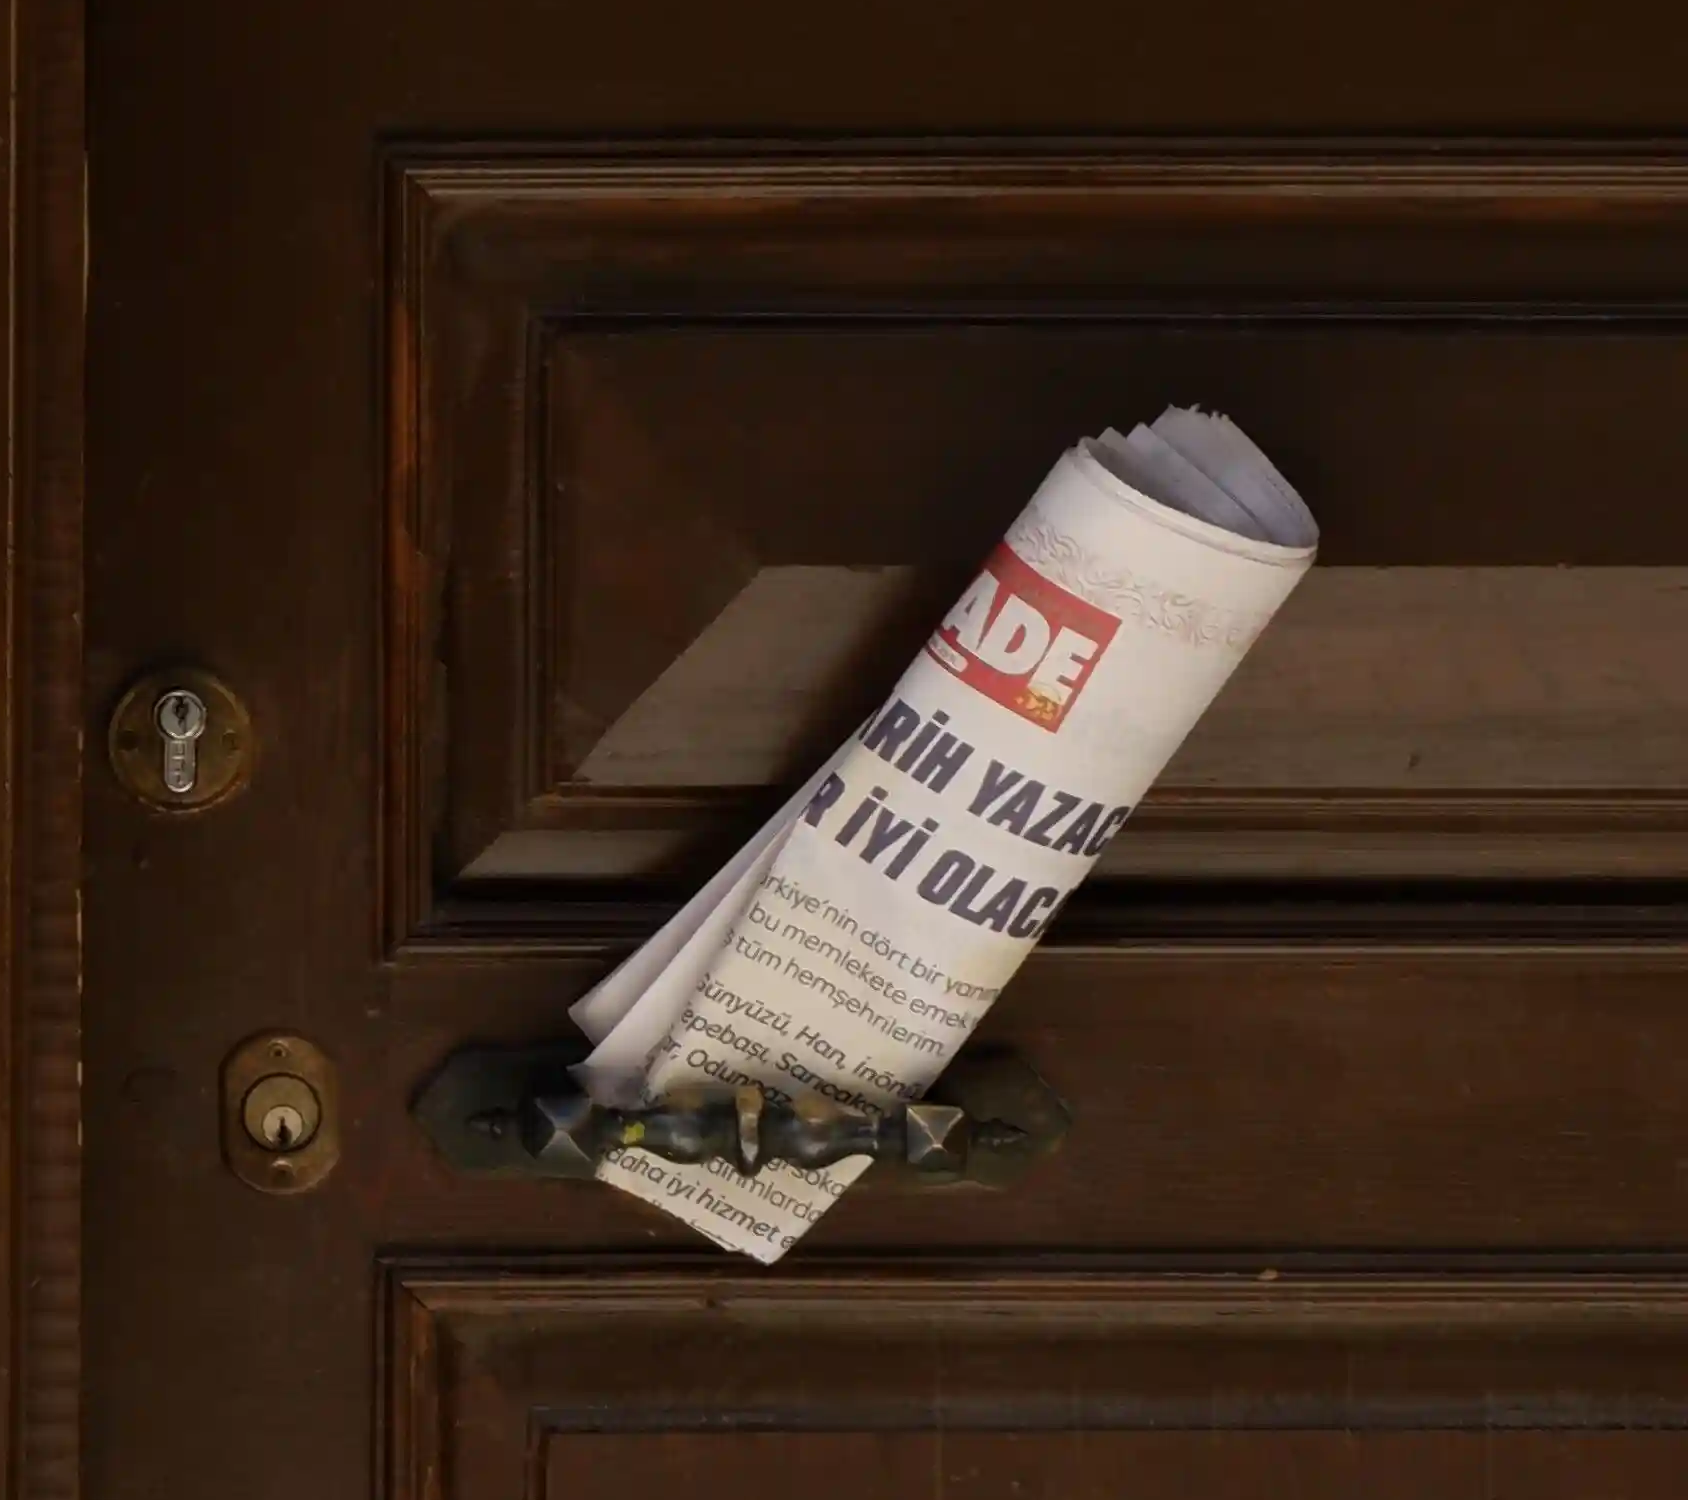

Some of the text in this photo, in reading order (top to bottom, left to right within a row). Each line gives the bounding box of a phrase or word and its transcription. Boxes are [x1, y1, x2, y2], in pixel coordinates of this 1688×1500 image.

[834, 786, 940, 880] İYİ
[735, 934, 782, 970] tüm
[749, 901, 780, 932] bu
[782, 923, 908, 1005] memlekete
[860, 927, 910, 970] dört
[910, 956, 946, 985] bir
[794, 1024, 847, 1070] Han,
[666, 1172, 702, 1202] iyi
[696, 1186, 781, 1243] hizmet
